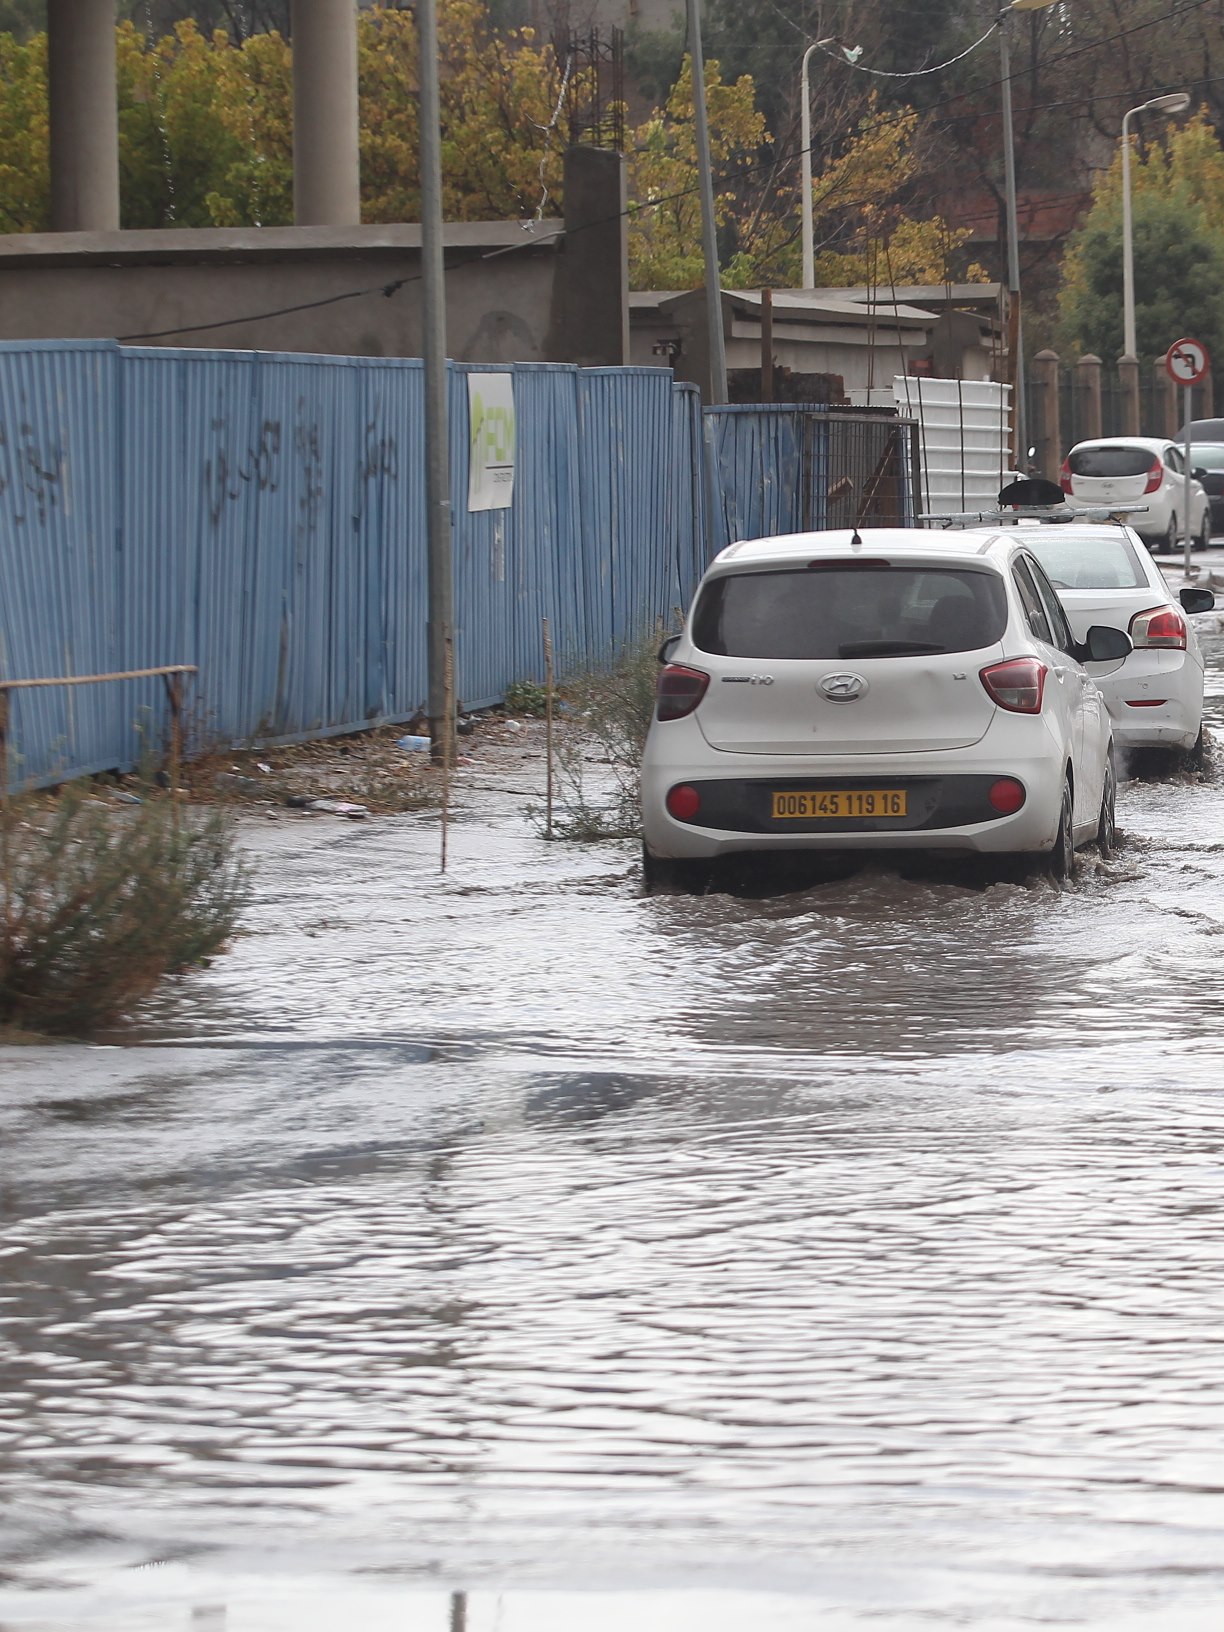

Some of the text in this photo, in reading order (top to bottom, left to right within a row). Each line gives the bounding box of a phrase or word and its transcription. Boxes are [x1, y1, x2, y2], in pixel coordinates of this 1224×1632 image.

[777, 793, 901, 816] 006145 119 16
